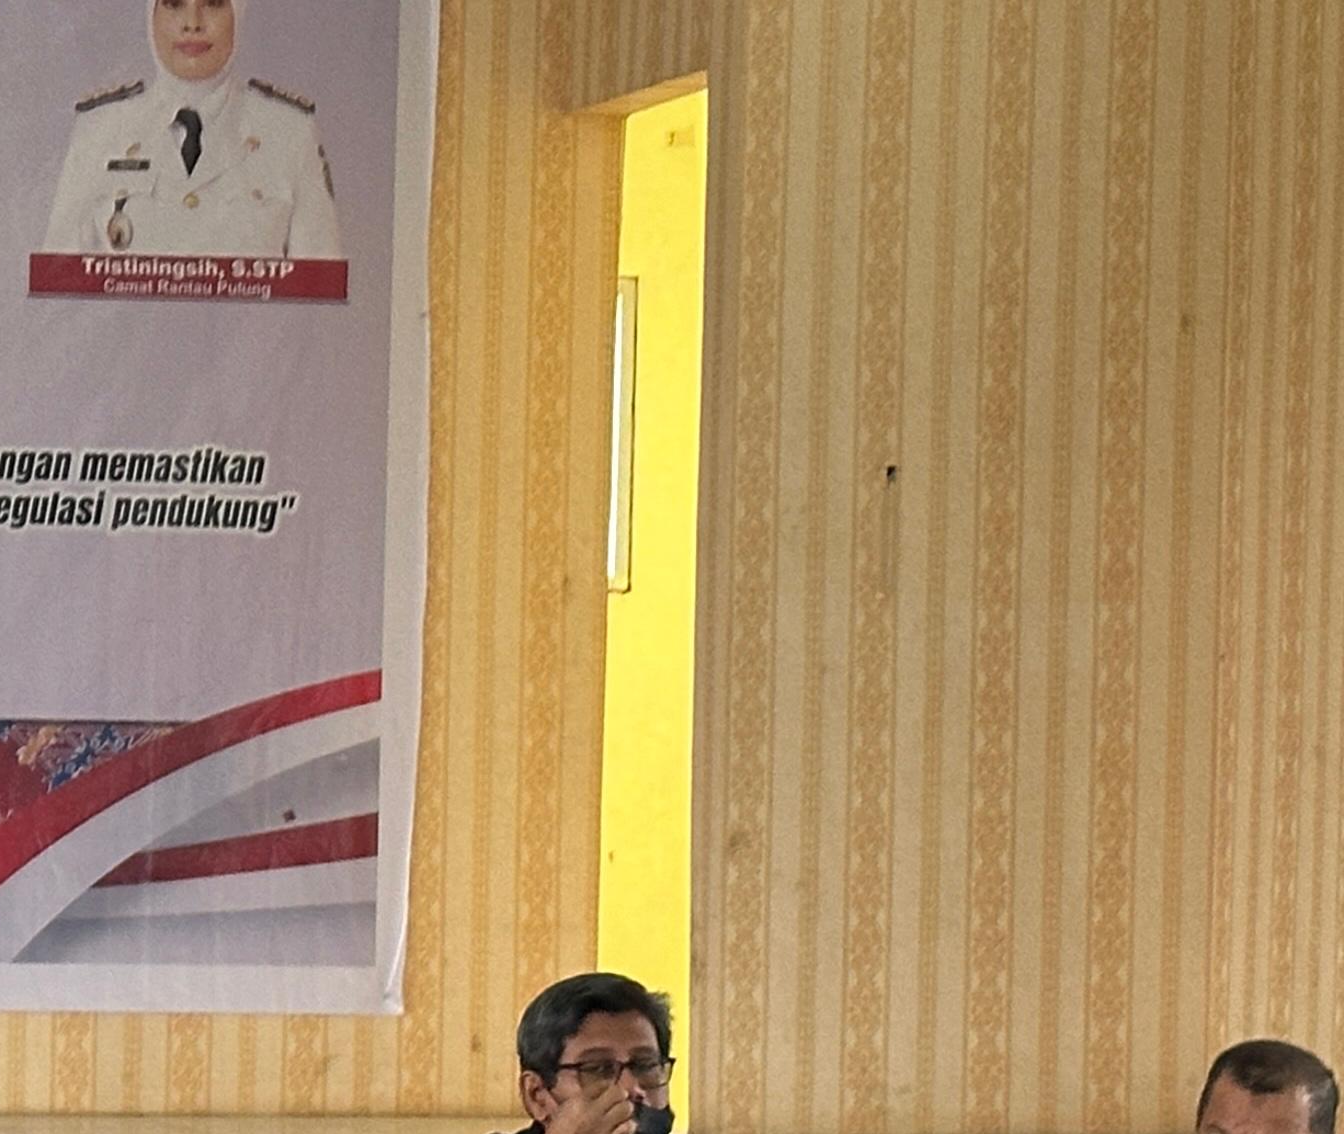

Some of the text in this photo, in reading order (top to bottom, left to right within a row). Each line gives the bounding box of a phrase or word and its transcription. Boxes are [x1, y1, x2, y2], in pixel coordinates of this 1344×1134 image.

[82, 257, 295, 279] Tristiningsih, S.STP
[103, 277, 272, 300] Camat Rantau Pulung
[79, 447, 266, 485] memastikan
